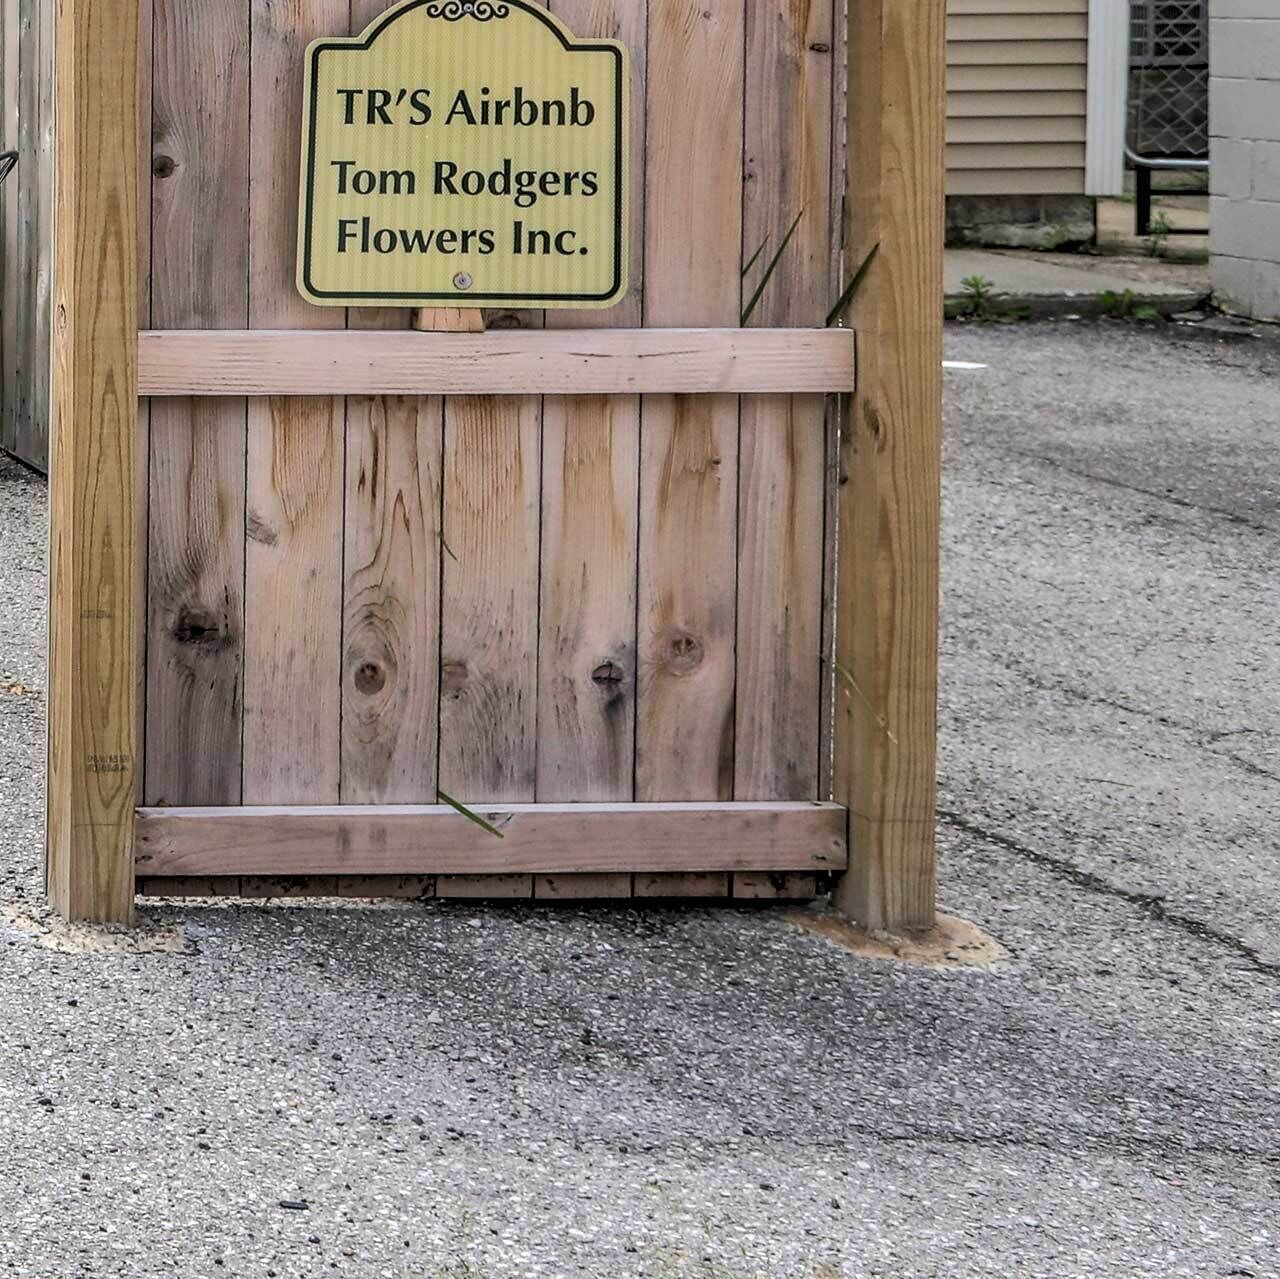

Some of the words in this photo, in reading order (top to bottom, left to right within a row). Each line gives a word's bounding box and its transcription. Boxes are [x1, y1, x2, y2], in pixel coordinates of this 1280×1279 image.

[336, 88, 432, 126] TR'S
[444, 86, 595, 127] Airbnb
[330, 160, 416, 195] Tom
[433, 158, 599, 208] Rodgers
[337, 216, 495, 255] Flowers
[512, 220, 589, 256] Inc.
